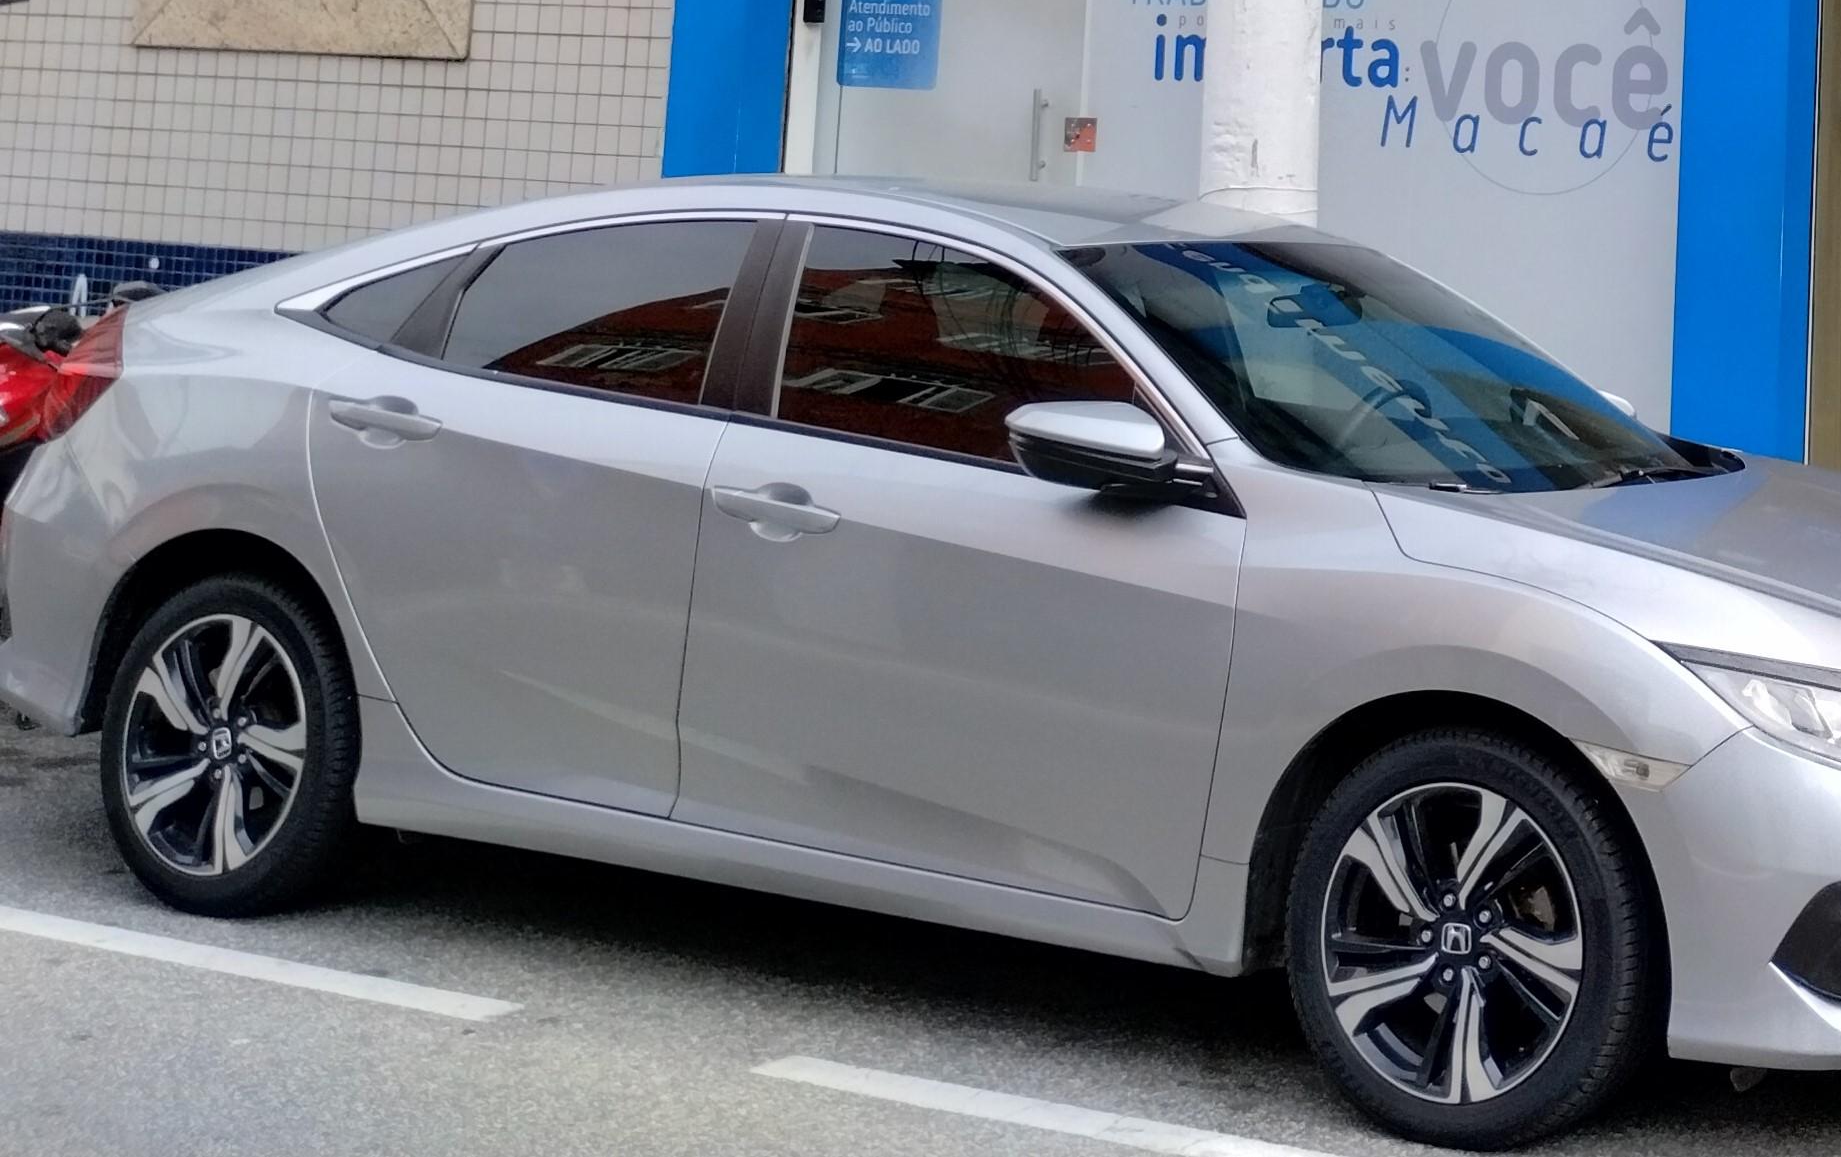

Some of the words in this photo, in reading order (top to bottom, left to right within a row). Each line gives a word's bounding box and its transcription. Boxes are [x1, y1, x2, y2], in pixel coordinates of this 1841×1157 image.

[849, 0, 931, 16] Atendimento
[847, 20, 863, 32] ao
[866, 17, 913, 34] Público
[1333, 16, 1396, 31] mais
[864, 40, 882, 53] AO
[886, 40, 921, 55] LADO
[1420, 7, 1669, 131] você
[1380, 94, 1674, 162] Macaé
